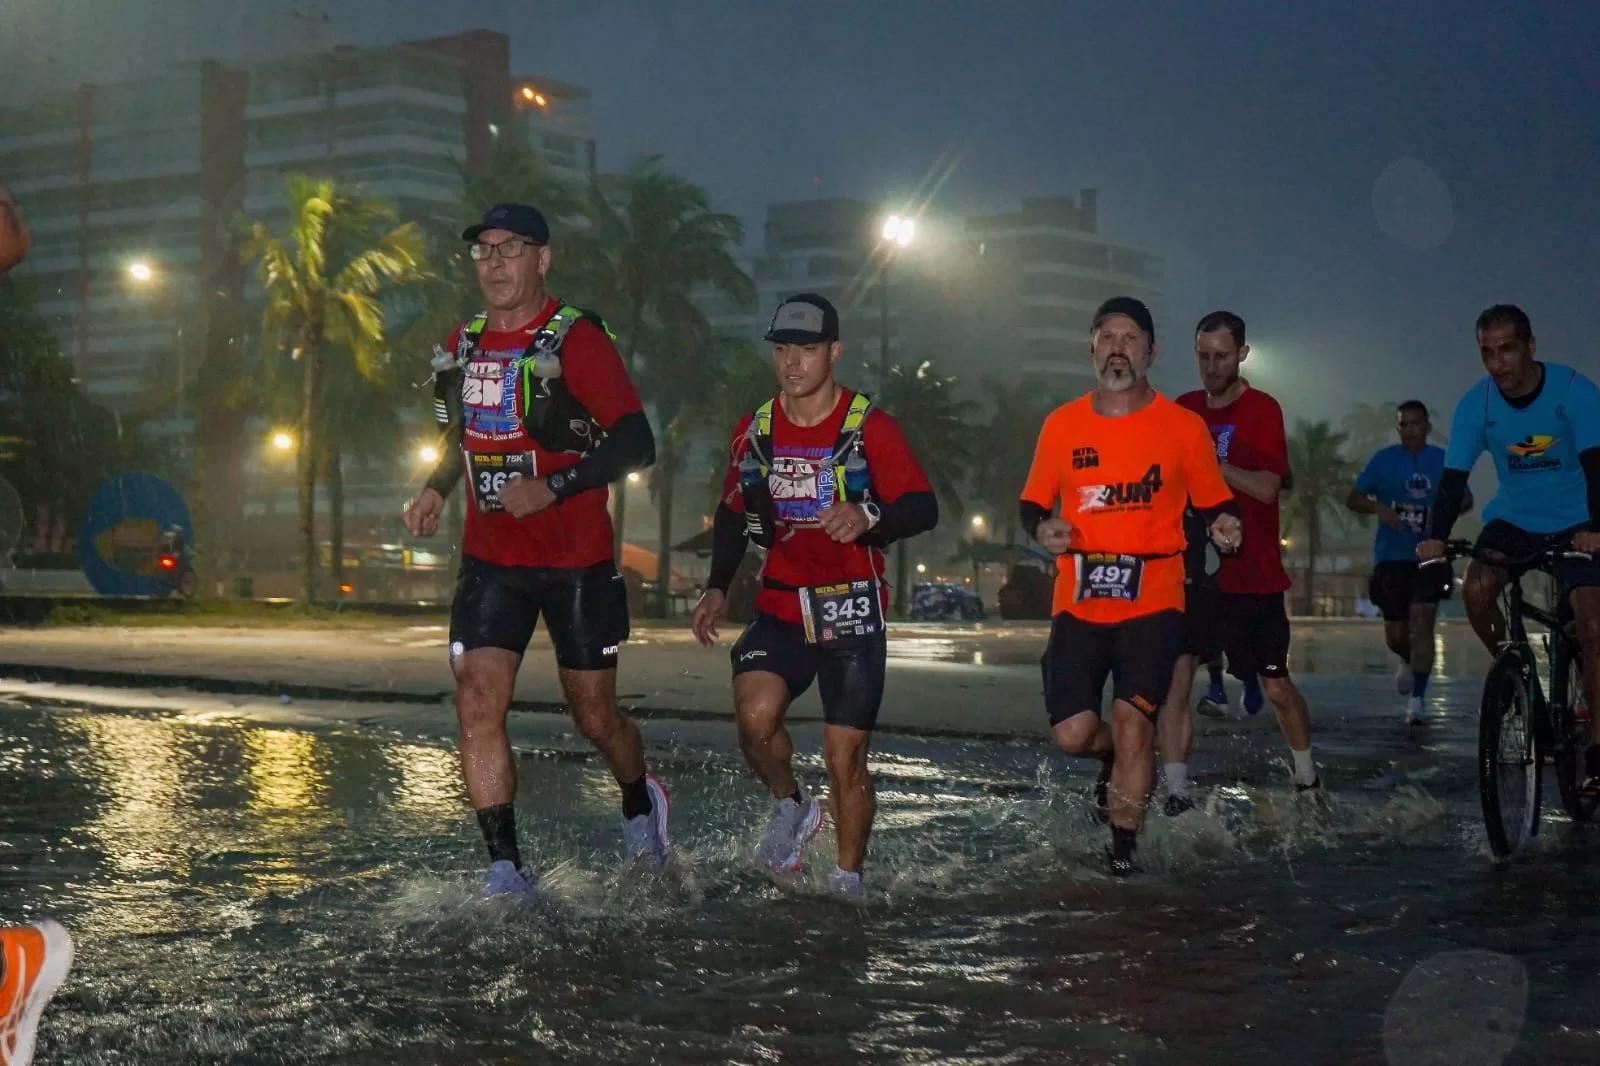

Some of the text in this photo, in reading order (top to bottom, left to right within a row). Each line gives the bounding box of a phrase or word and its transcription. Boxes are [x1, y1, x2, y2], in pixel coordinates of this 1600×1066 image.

[505, 455, 524, 463] 75K
[479, 471, 522, 493] 36
[1088, 565, 1132, 584] 491
[851, 580, 869, 589] 75K
[822, 596, 870, 622] 343
